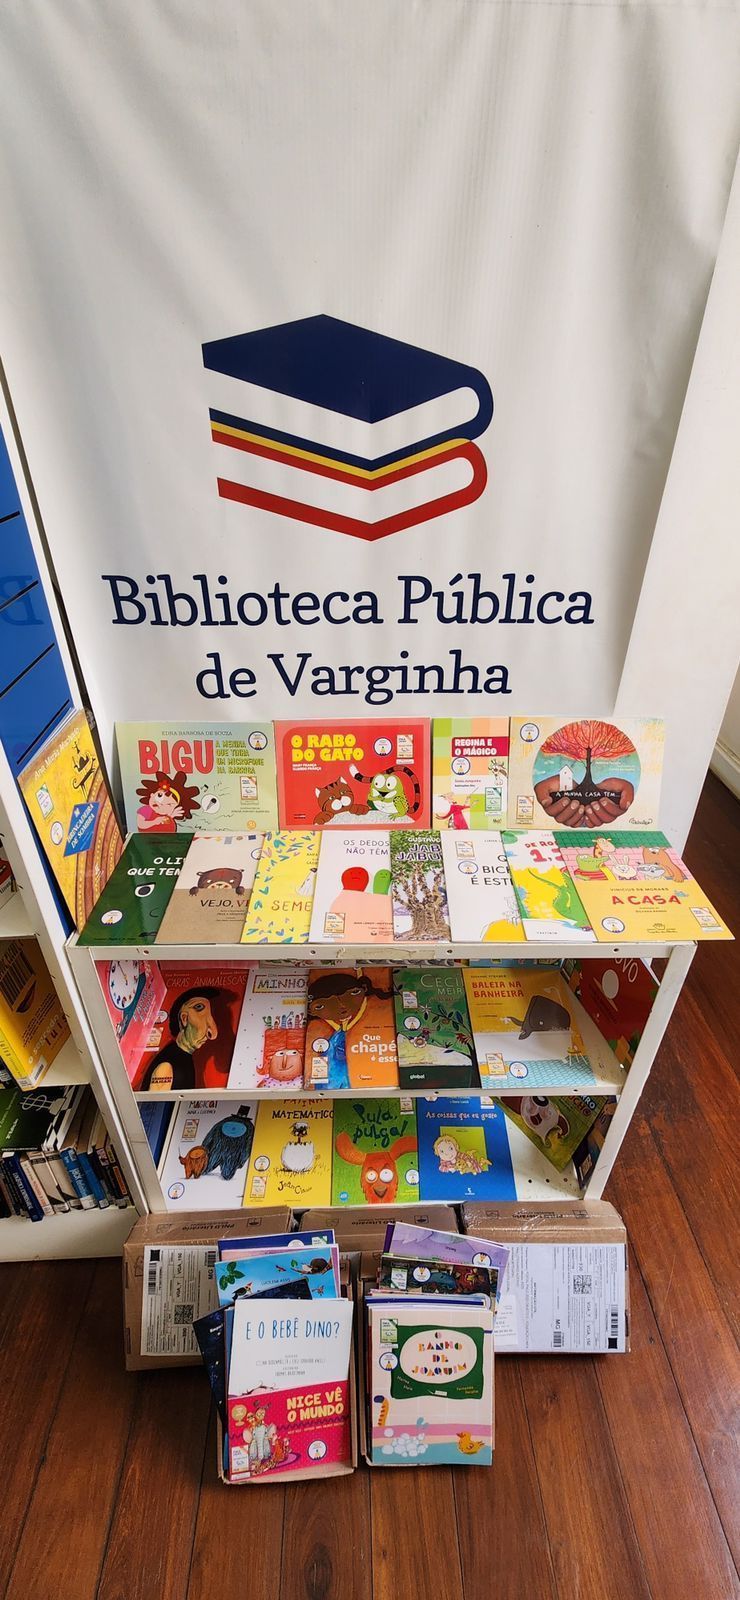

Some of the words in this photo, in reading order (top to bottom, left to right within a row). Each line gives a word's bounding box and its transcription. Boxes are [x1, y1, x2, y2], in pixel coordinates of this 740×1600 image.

[101, 574, 384, 626] Biblioteca
[397, 573, 595, 625] Pública
[196, 652, 257, 699] de
[267, 650, 512, 705] Varginha
[291, 735, 303, 748] O
[307, 734, 356, 748] RABO
[216, 749, 229, 757] QUE
[231, 749, 249, 757] TINHA
[292, 749, 315, 762] DO
[320, 748, 364, 761] GATO
[463, 746, 497, 755] MÁGICO
[138, 739, 215, 775] BIGU
[217, 758, 226, 766] UM
[228, 758, 264, 766] MICROFONE
[524, 841, 537, 849] DE
[345, 847, 365, 855] NÃO
[370, 847, 389, 855] TÊM
[397, 852, 443, 860] JABU
[153, 857, 164, 865] O
[166, 857, 186, 865] LI
[127, 868, 155, 876] QUE
[471, 875, 479, 885] É
[200, 899, 234, 908] VEJO,
[612, 895, 625, 905] A
[627, 894, 681, 905] CASA
[166, 977, 190, 988] CARAS
[194, 975, 248, 987] ANIMALESCAS
[257, 978, 309, 989] MINHO
[472, 981, 506, 989] BALEIA
[473, 989, 524, 998] BANHEIRA
[362, 1034, 381, 1042] Que
[350, 1040, 397, 1055] chapé
[353, 1104, 398, 1125] Pula,
[459, 1112, 470, 1120] que
[481, 1112, 497, 1120] gosto
[353, 1120, 408, 1149] pulga!
[207, 1269, 214, 1280] MG
[246, 1321, 251, 1340] E
[258, 1321, 264, 1339] O
[272, 1317, 299, 1339] BEBÊ
[305, 1321, 340, 1339] DINO?
[555, 1319, 561, 1330] MG
[418, 1341, 463, 1352] BANHO
[432, 1354, 449, 1362] DE
[411, 1362, 467, 1377] JOAQUIM
[286, 1392, 321, 1411] NICE
[325, 1386, 343, 1403] VÊ
[287, 1410, 297, 1423] O
[300, 1402, 344, 1421] MUNDO
